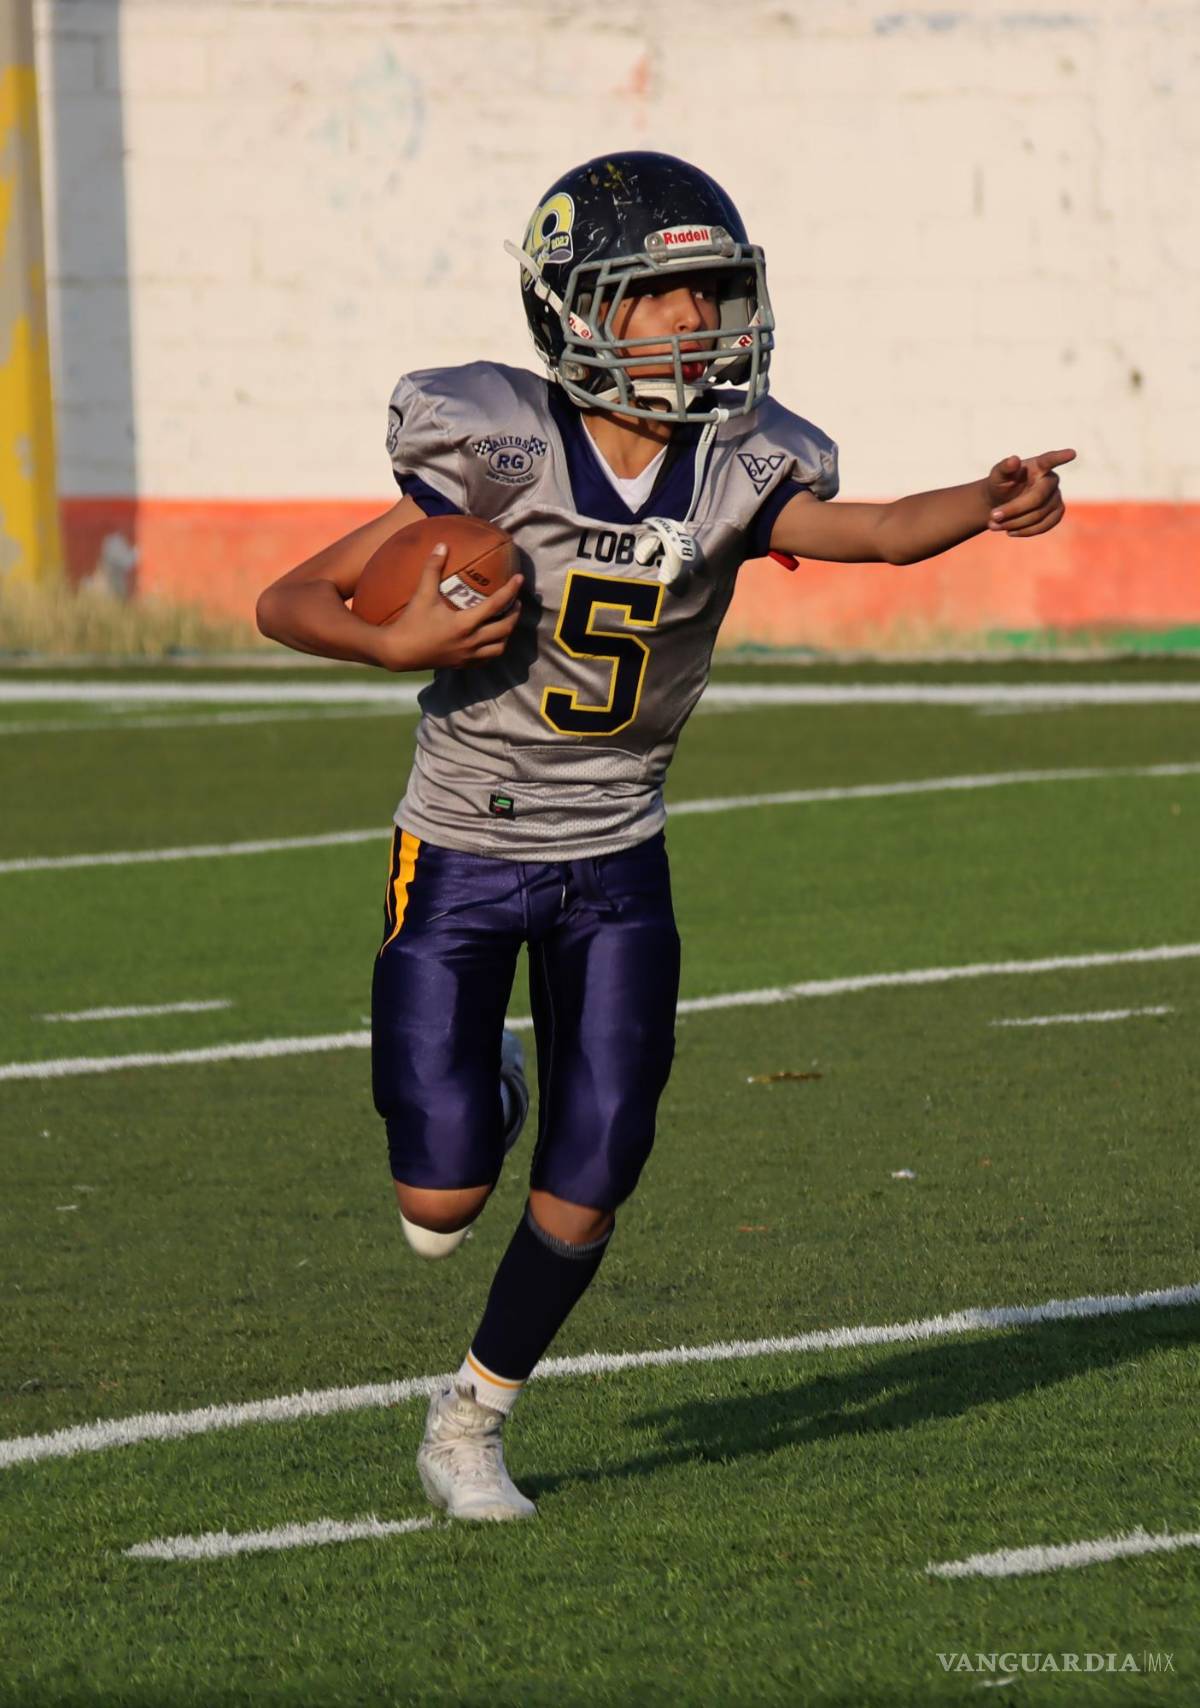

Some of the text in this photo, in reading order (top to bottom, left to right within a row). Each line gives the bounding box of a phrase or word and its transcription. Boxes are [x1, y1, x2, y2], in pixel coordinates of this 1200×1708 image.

[663, 229, 709, 244] Riddell
[491, 435, 530, 449] AUTOS
[496, 453, 525, 469] RG
[576, 529, 664, 568] LOB
[540, 568, 667, 737] 5
